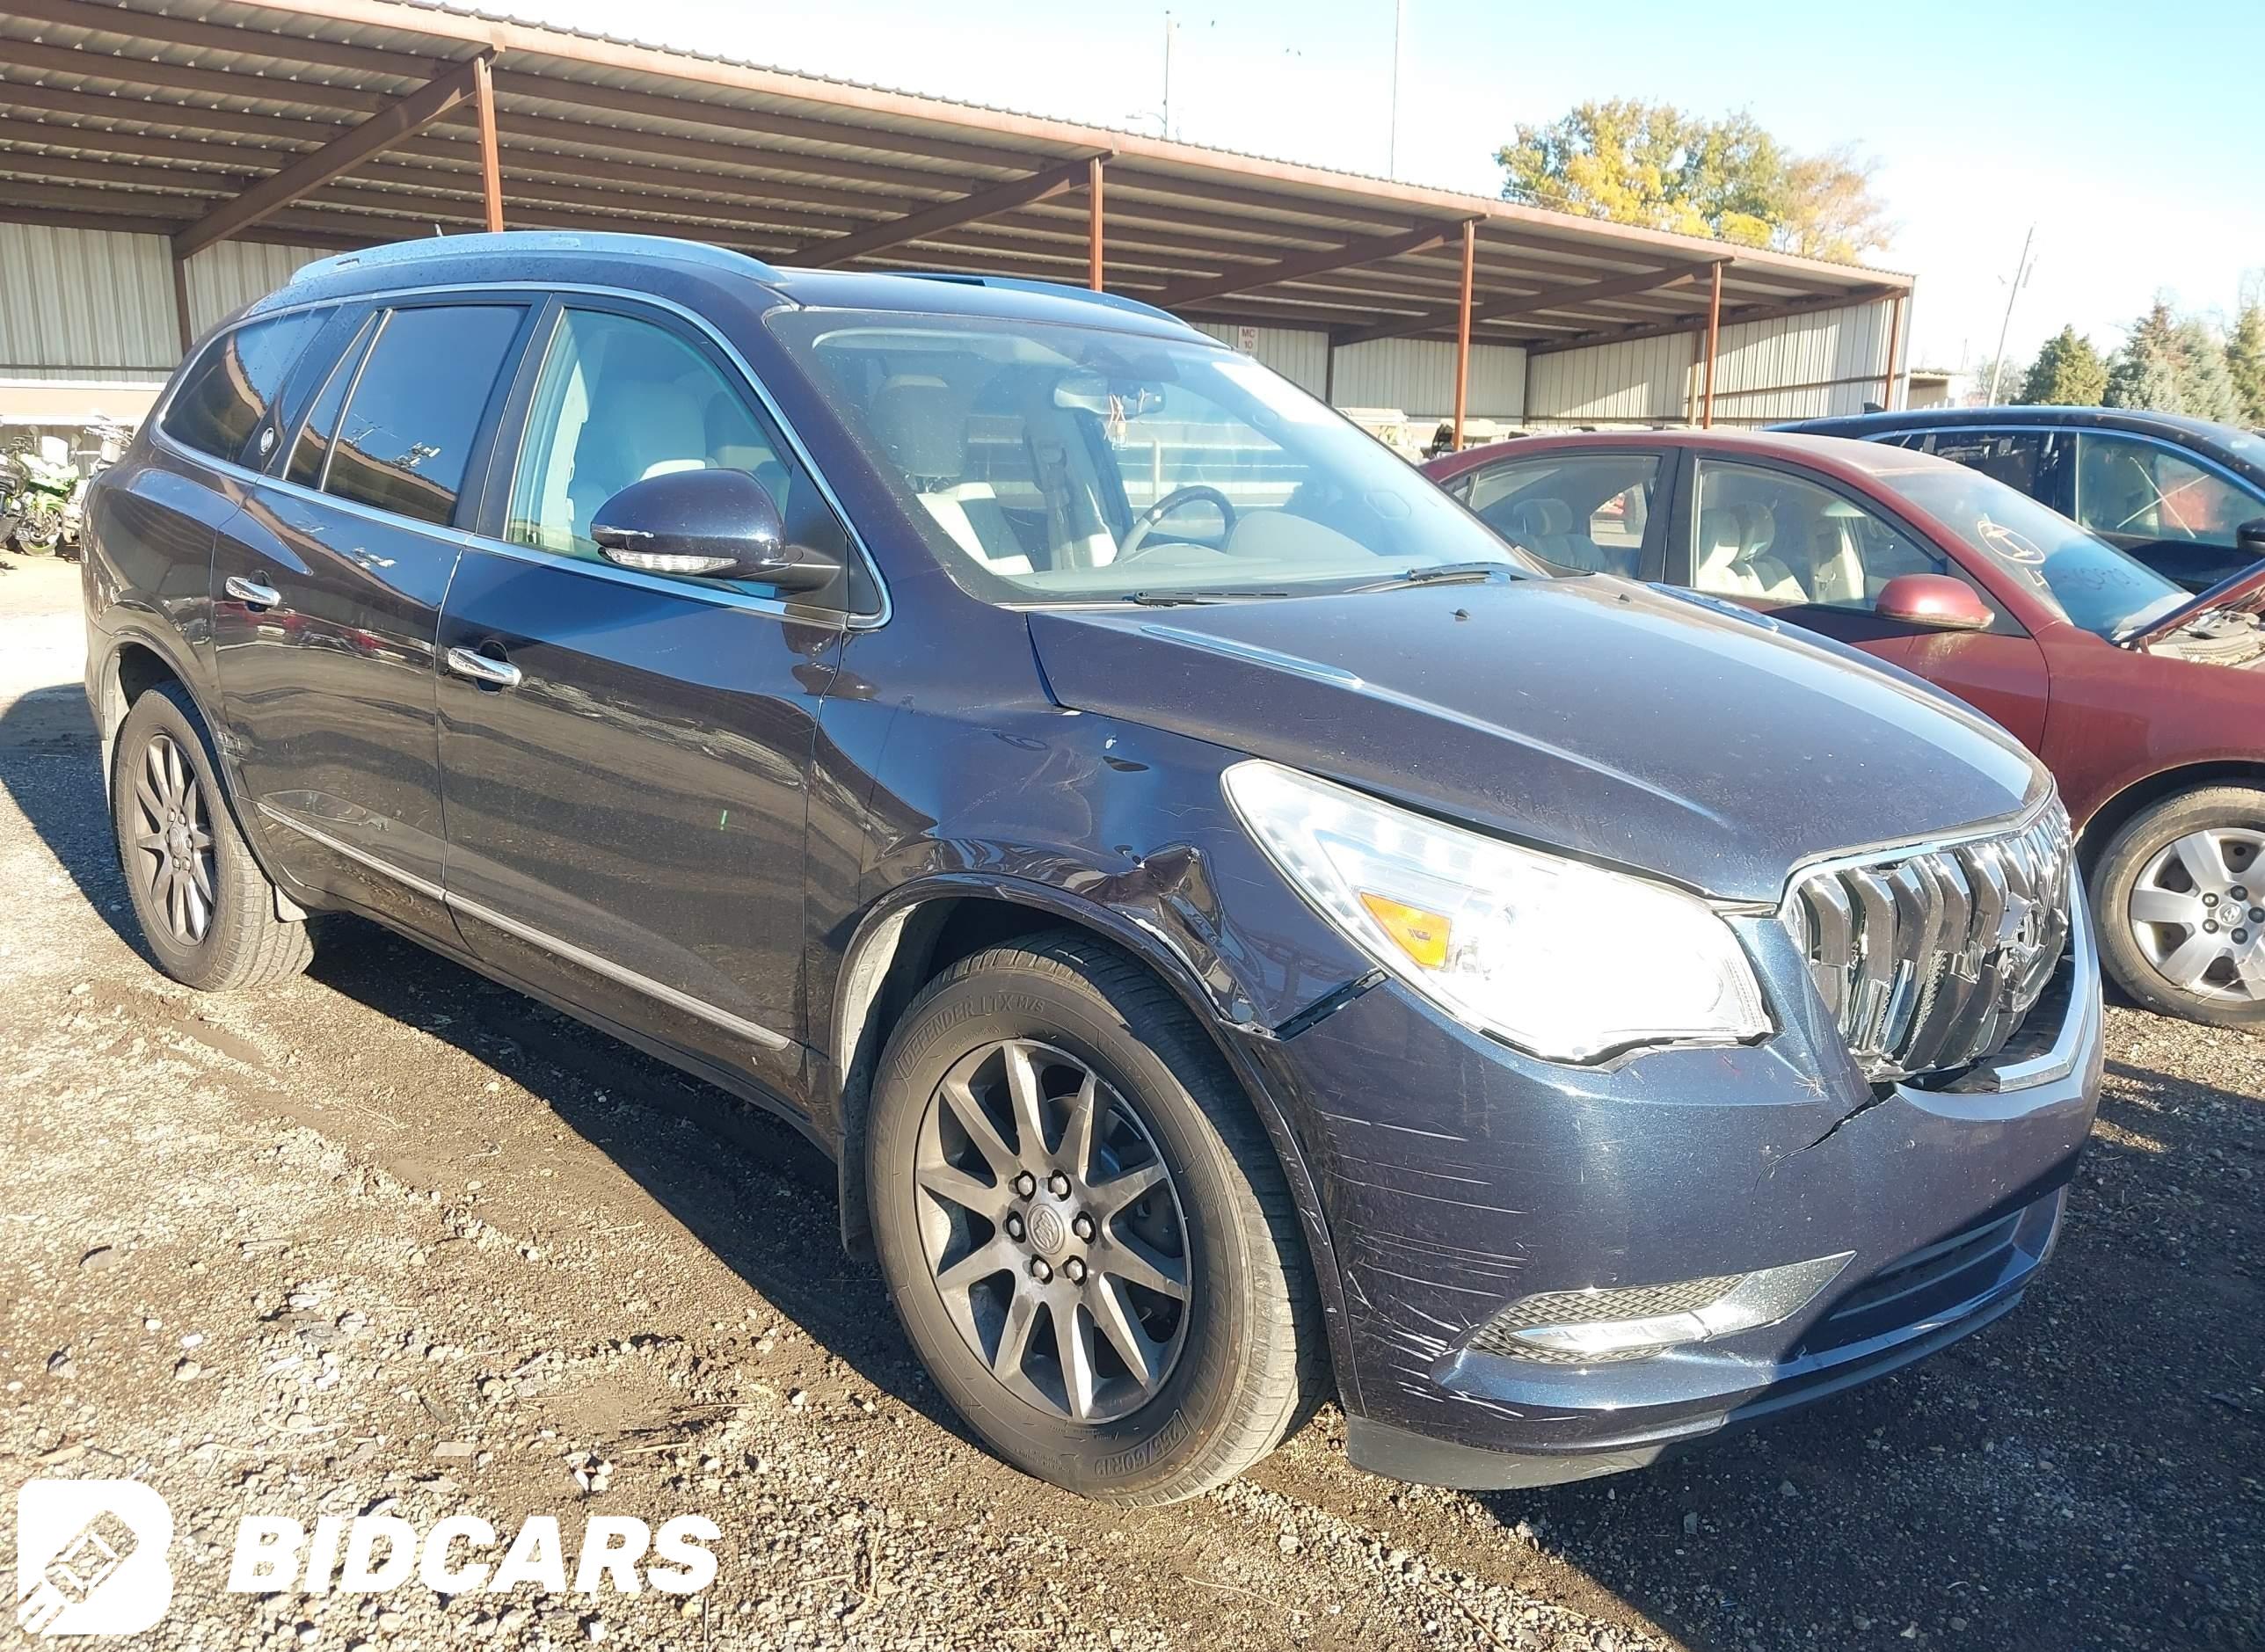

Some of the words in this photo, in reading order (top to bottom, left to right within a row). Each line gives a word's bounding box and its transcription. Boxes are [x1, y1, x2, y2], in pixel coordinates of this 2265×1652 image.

[1242, 328, 1255, 338] MC
[901, 998, 974, 1070] DEFENDER
[1017, 994, 1045, 1013] M/S
